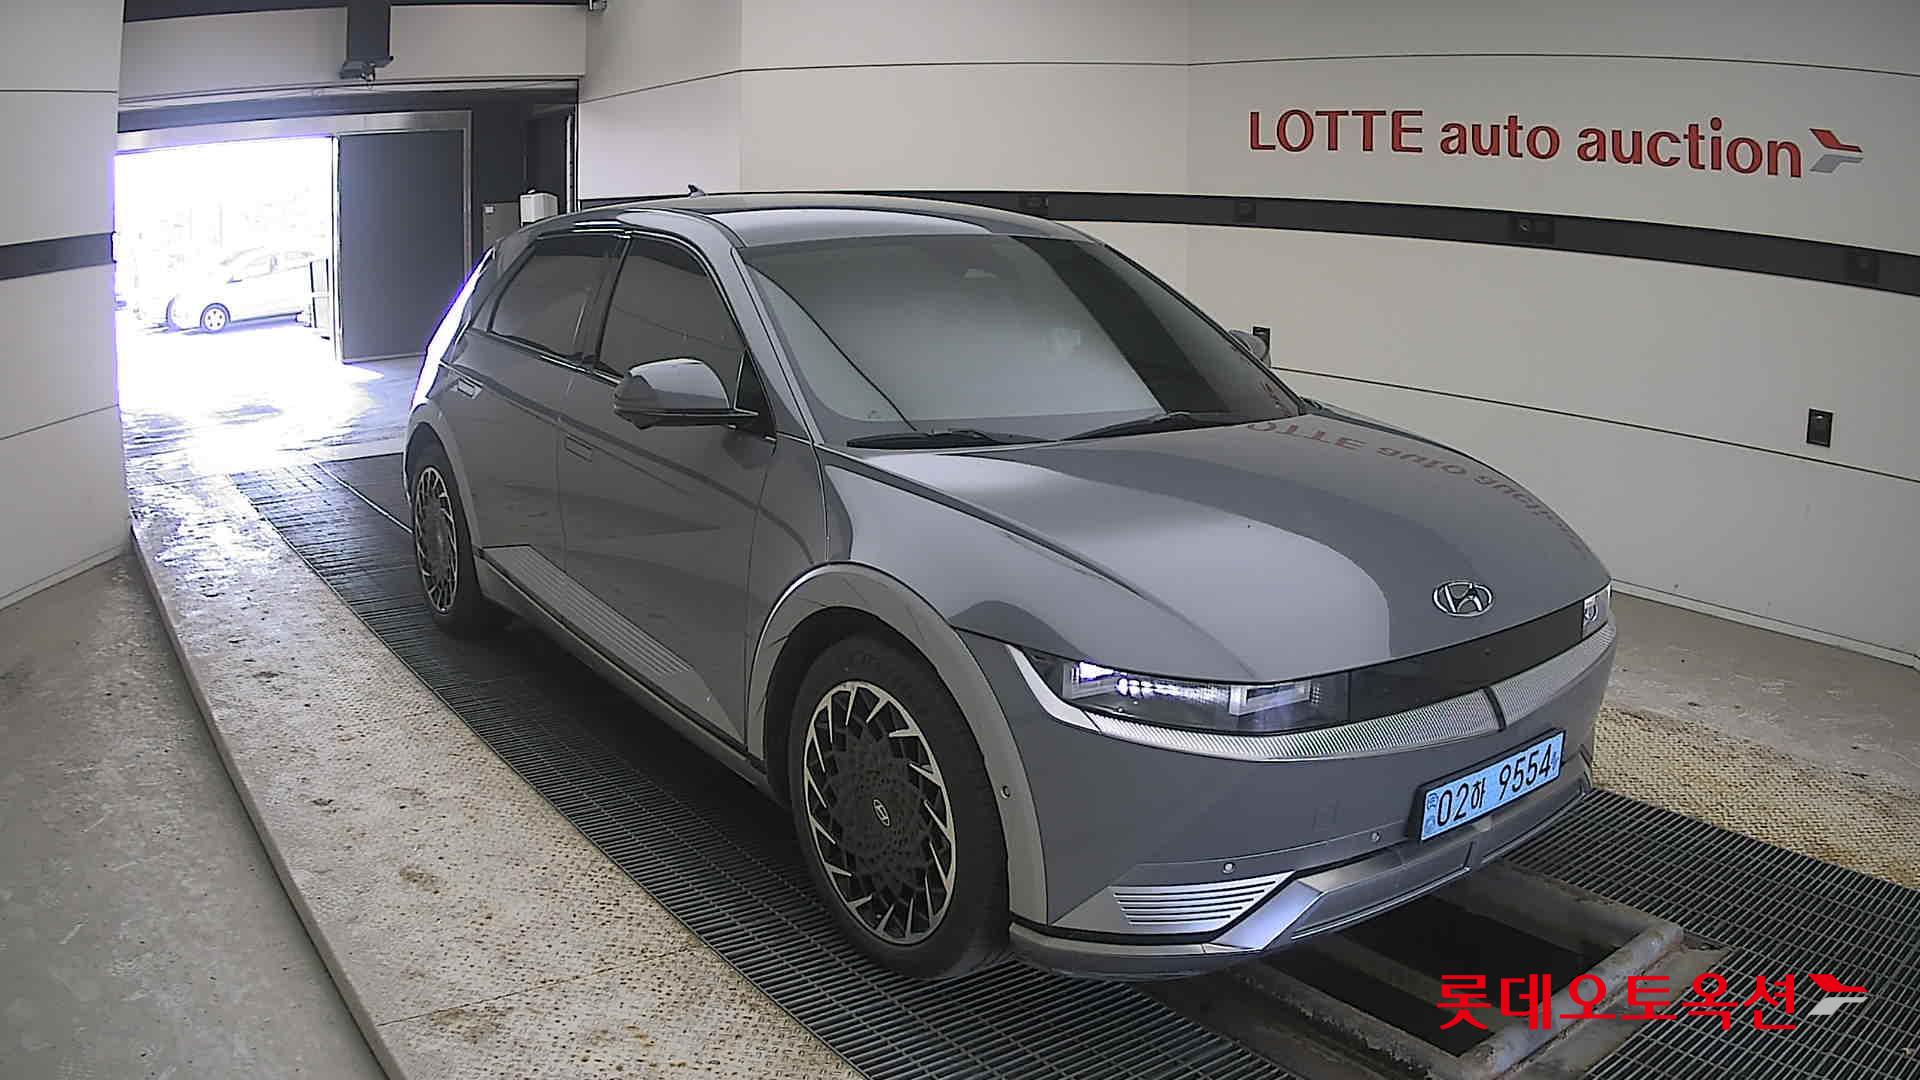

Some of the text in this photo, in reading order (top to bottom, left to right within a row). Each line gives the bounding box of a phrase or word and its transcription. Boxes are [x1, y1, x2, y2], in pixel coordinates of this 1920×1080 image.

[1249, 109, 1802, 179] LOTTE auto auction
[1436, 743, 1552, 827] 02하 9554
